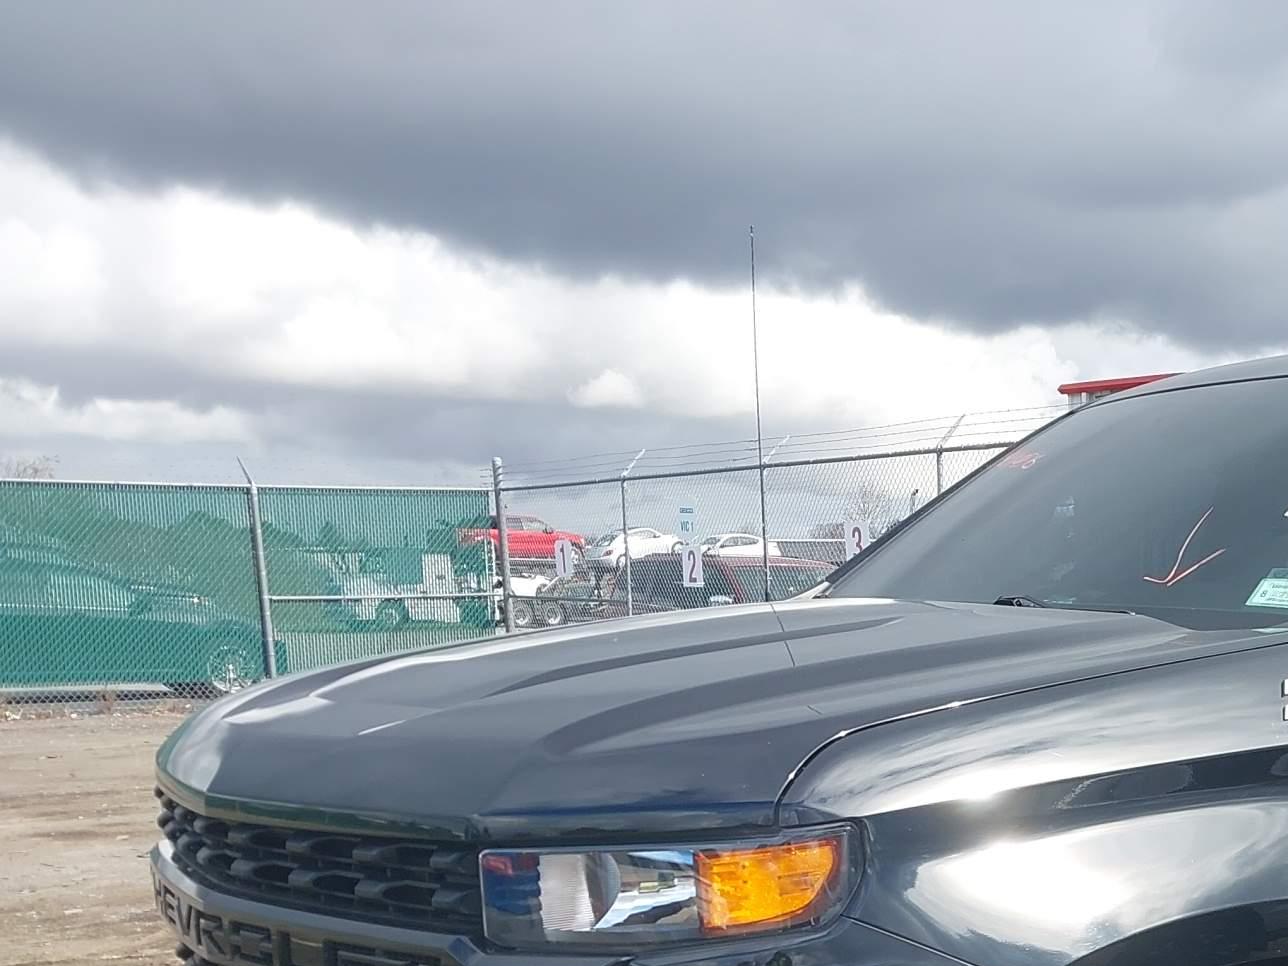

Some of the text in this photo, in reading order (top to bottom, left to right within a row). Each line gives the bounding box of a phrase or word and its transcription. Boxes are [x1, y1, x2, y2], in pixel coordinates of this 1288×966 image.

[852, 526, 863, 555] 3
[560, 543, 567, 574] 1
[687, 550, 698, 584] 2
